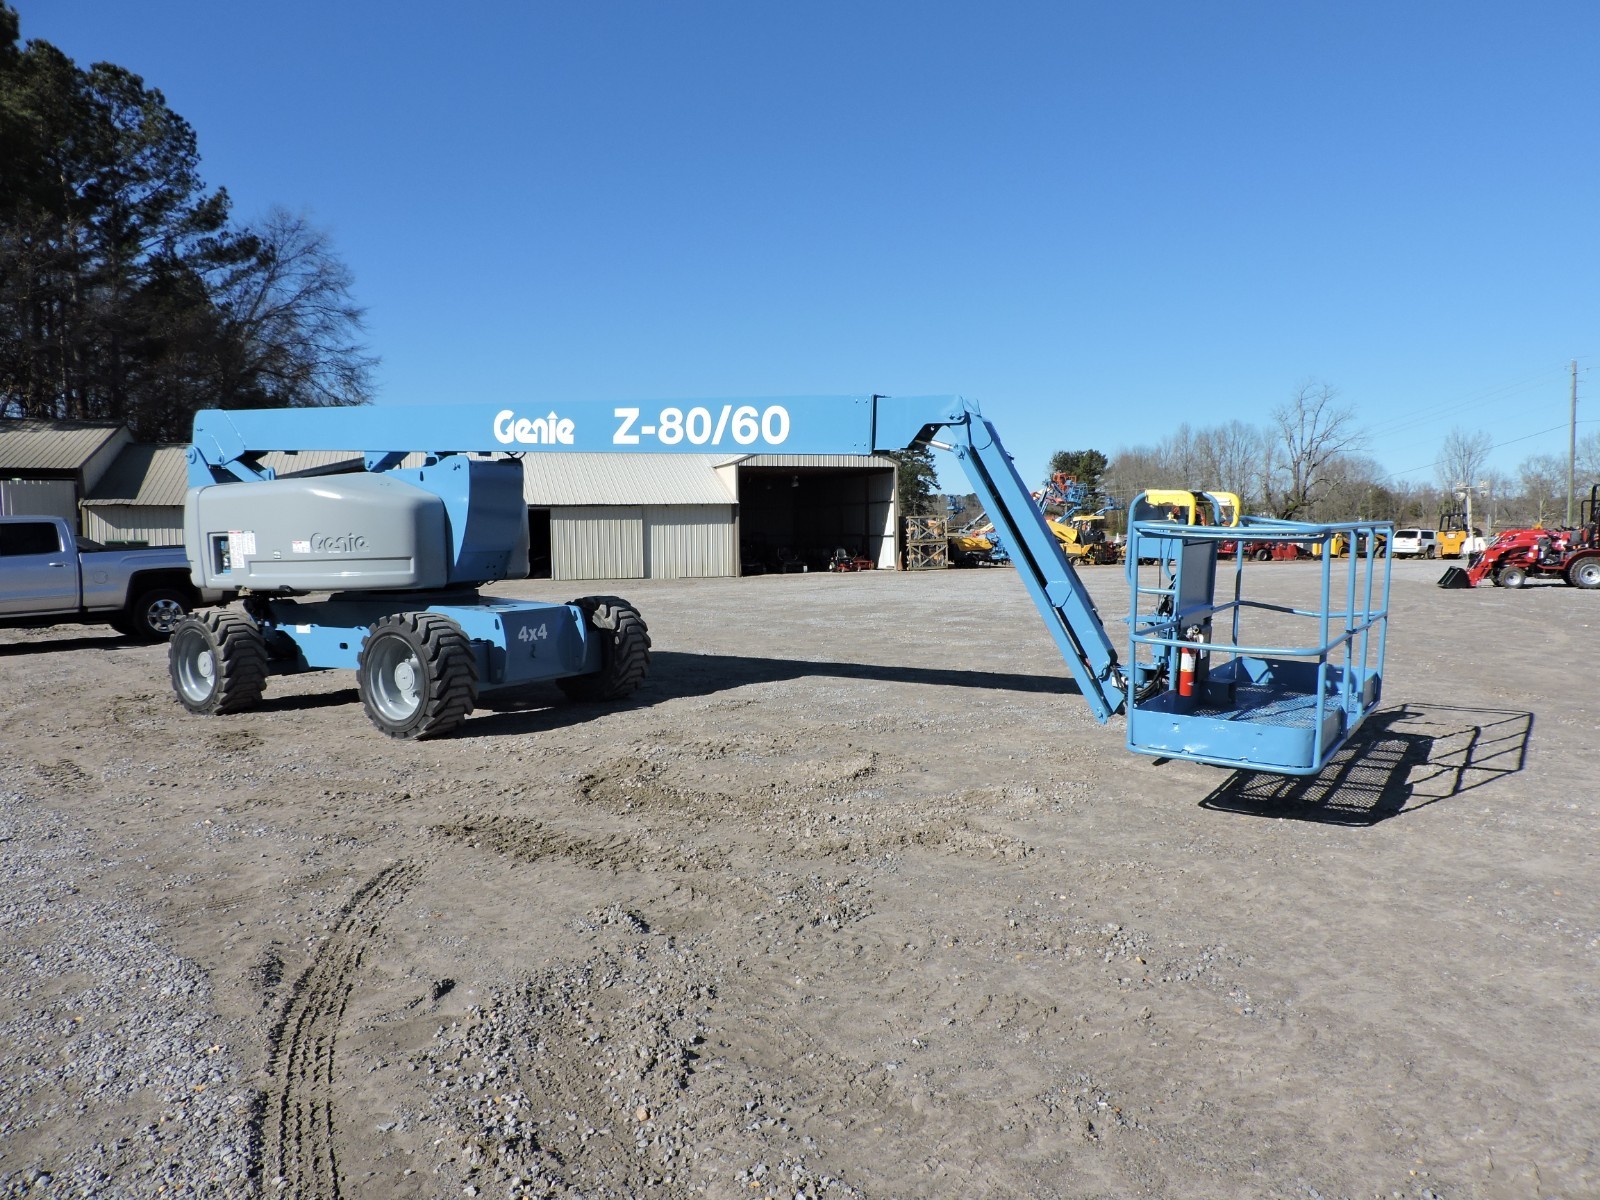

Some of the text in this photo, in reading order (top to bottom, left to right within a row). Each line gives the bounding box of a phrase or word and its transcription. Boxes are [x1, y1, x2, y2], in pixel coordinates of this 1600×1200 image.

[493, 409, 575, 444] Genie
[612, 404, 790, 445] Z-80/60
[518, 623, 547, 642] 4x4
